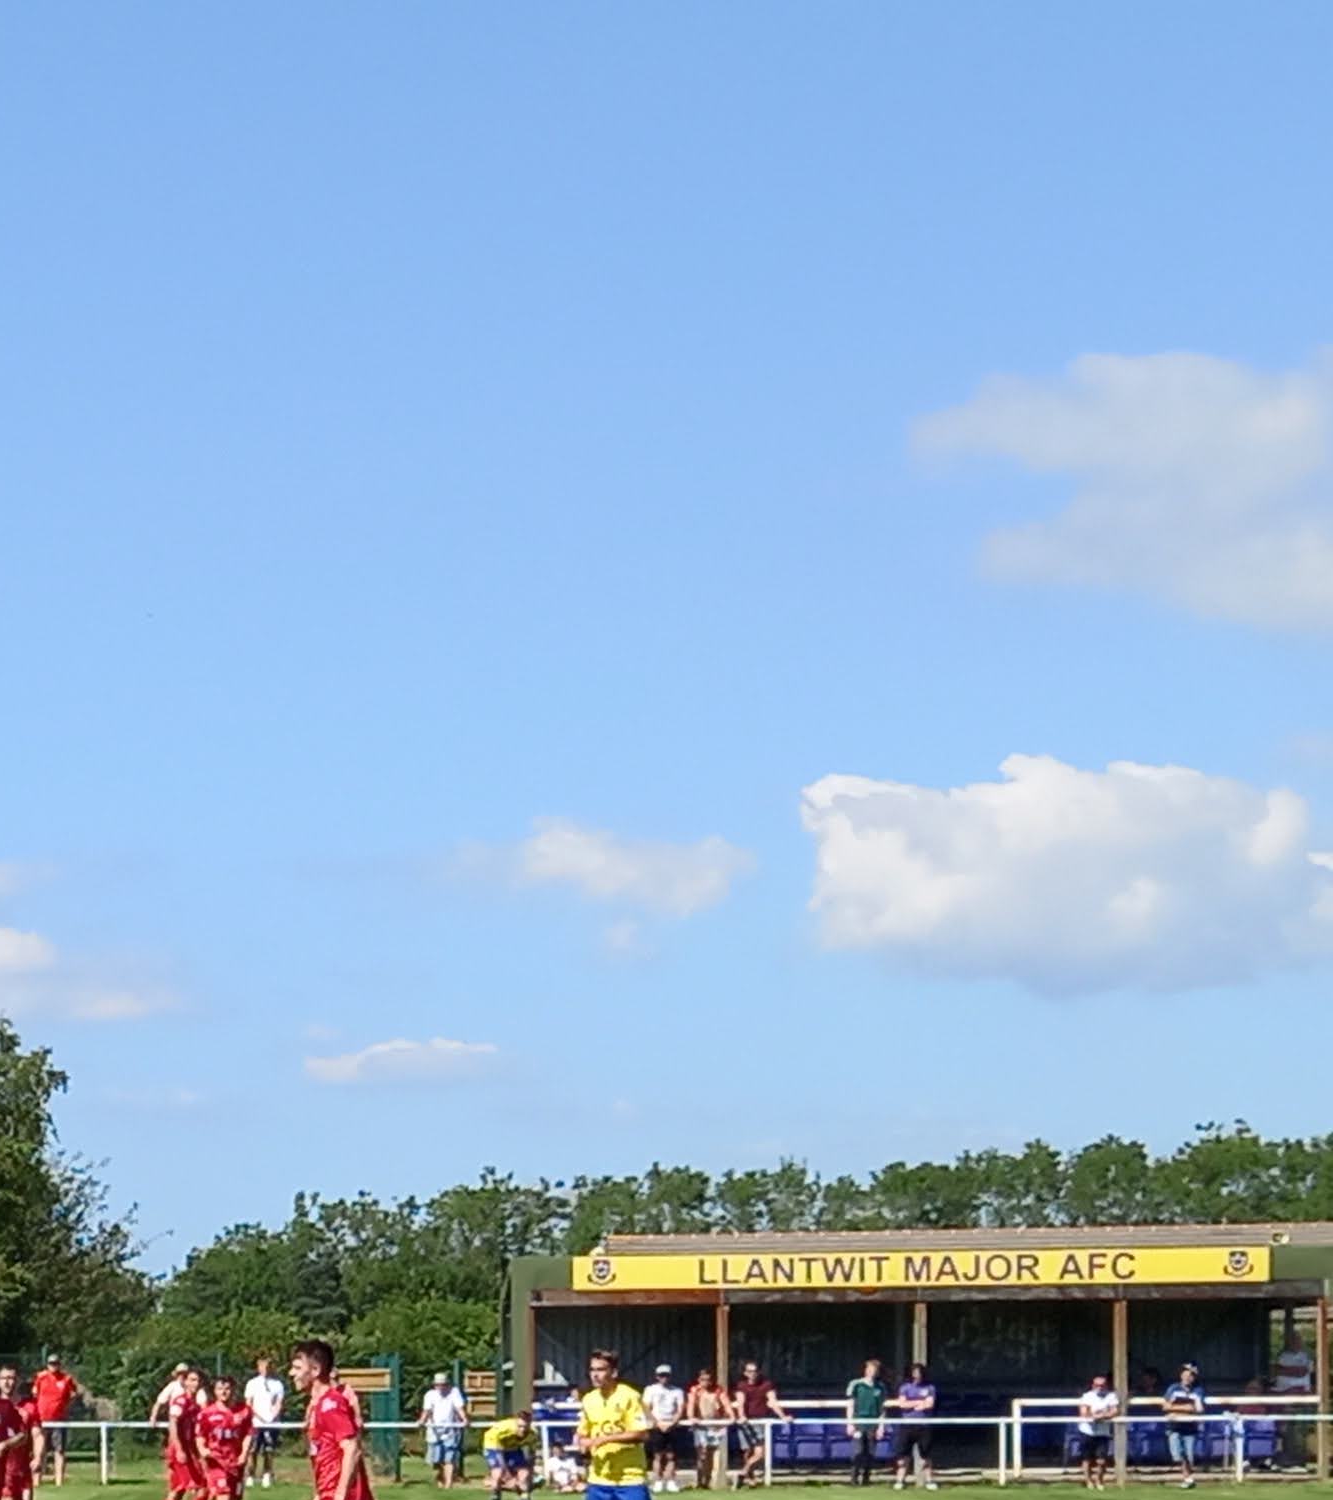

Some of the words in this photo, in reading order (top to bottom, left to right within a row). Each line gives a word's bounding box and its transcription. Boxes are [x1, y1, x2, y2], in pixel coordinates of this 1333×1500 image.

[698, 1255, 890, 1284] LLANTWIT
[903, 1254, 1039, 1282] MAJOR
[1059, 1252, 1137, 1280] AFC
